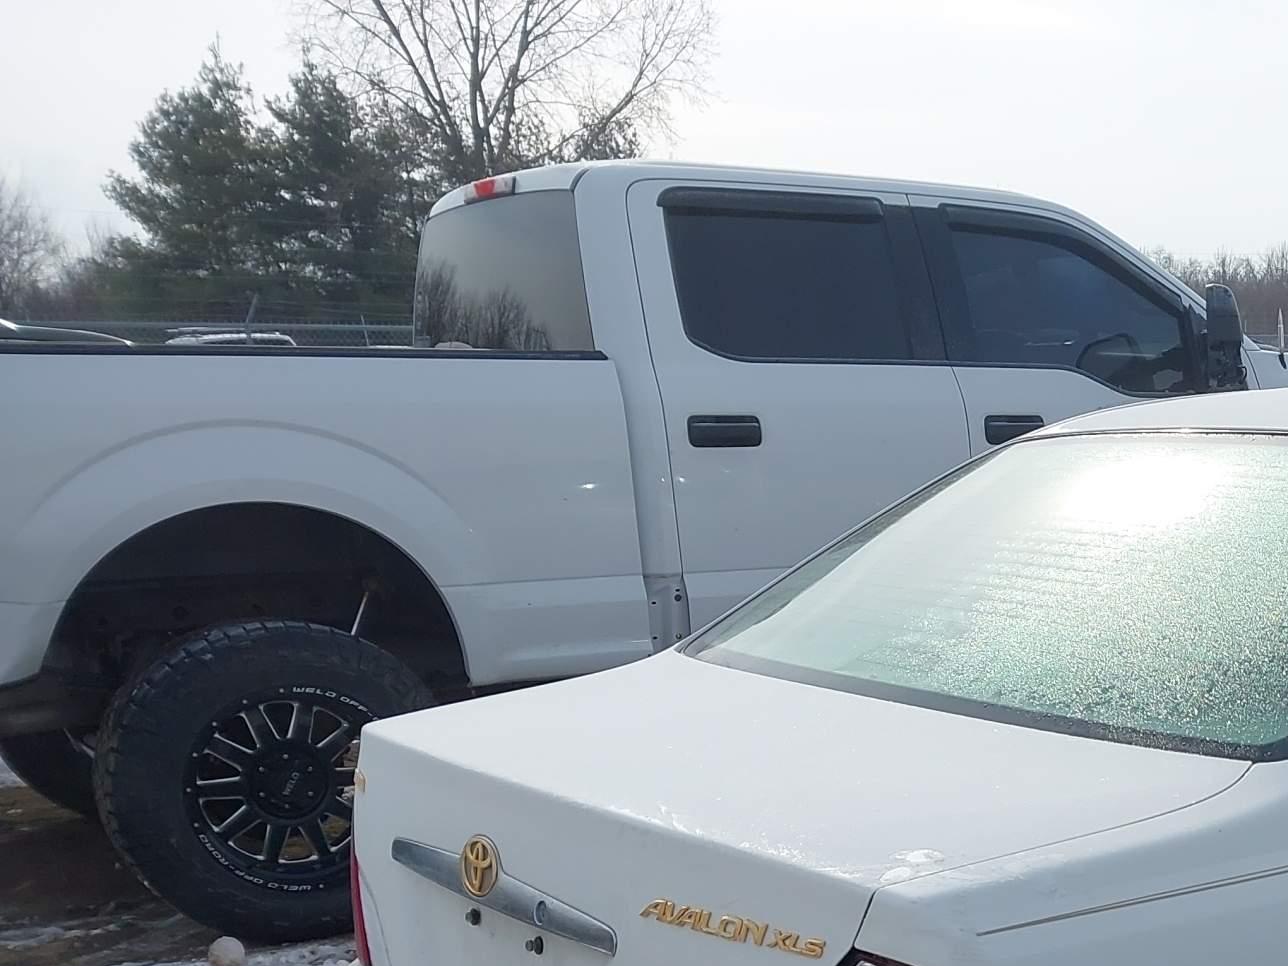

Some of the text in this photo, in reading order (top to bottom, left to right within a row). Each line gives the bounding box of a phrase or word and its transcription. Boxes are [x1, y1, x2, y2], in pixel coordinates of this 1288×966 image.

[292, 686, 381, 721] WELD OFF-
[639, 898, 826, 960] AVALON XLS
